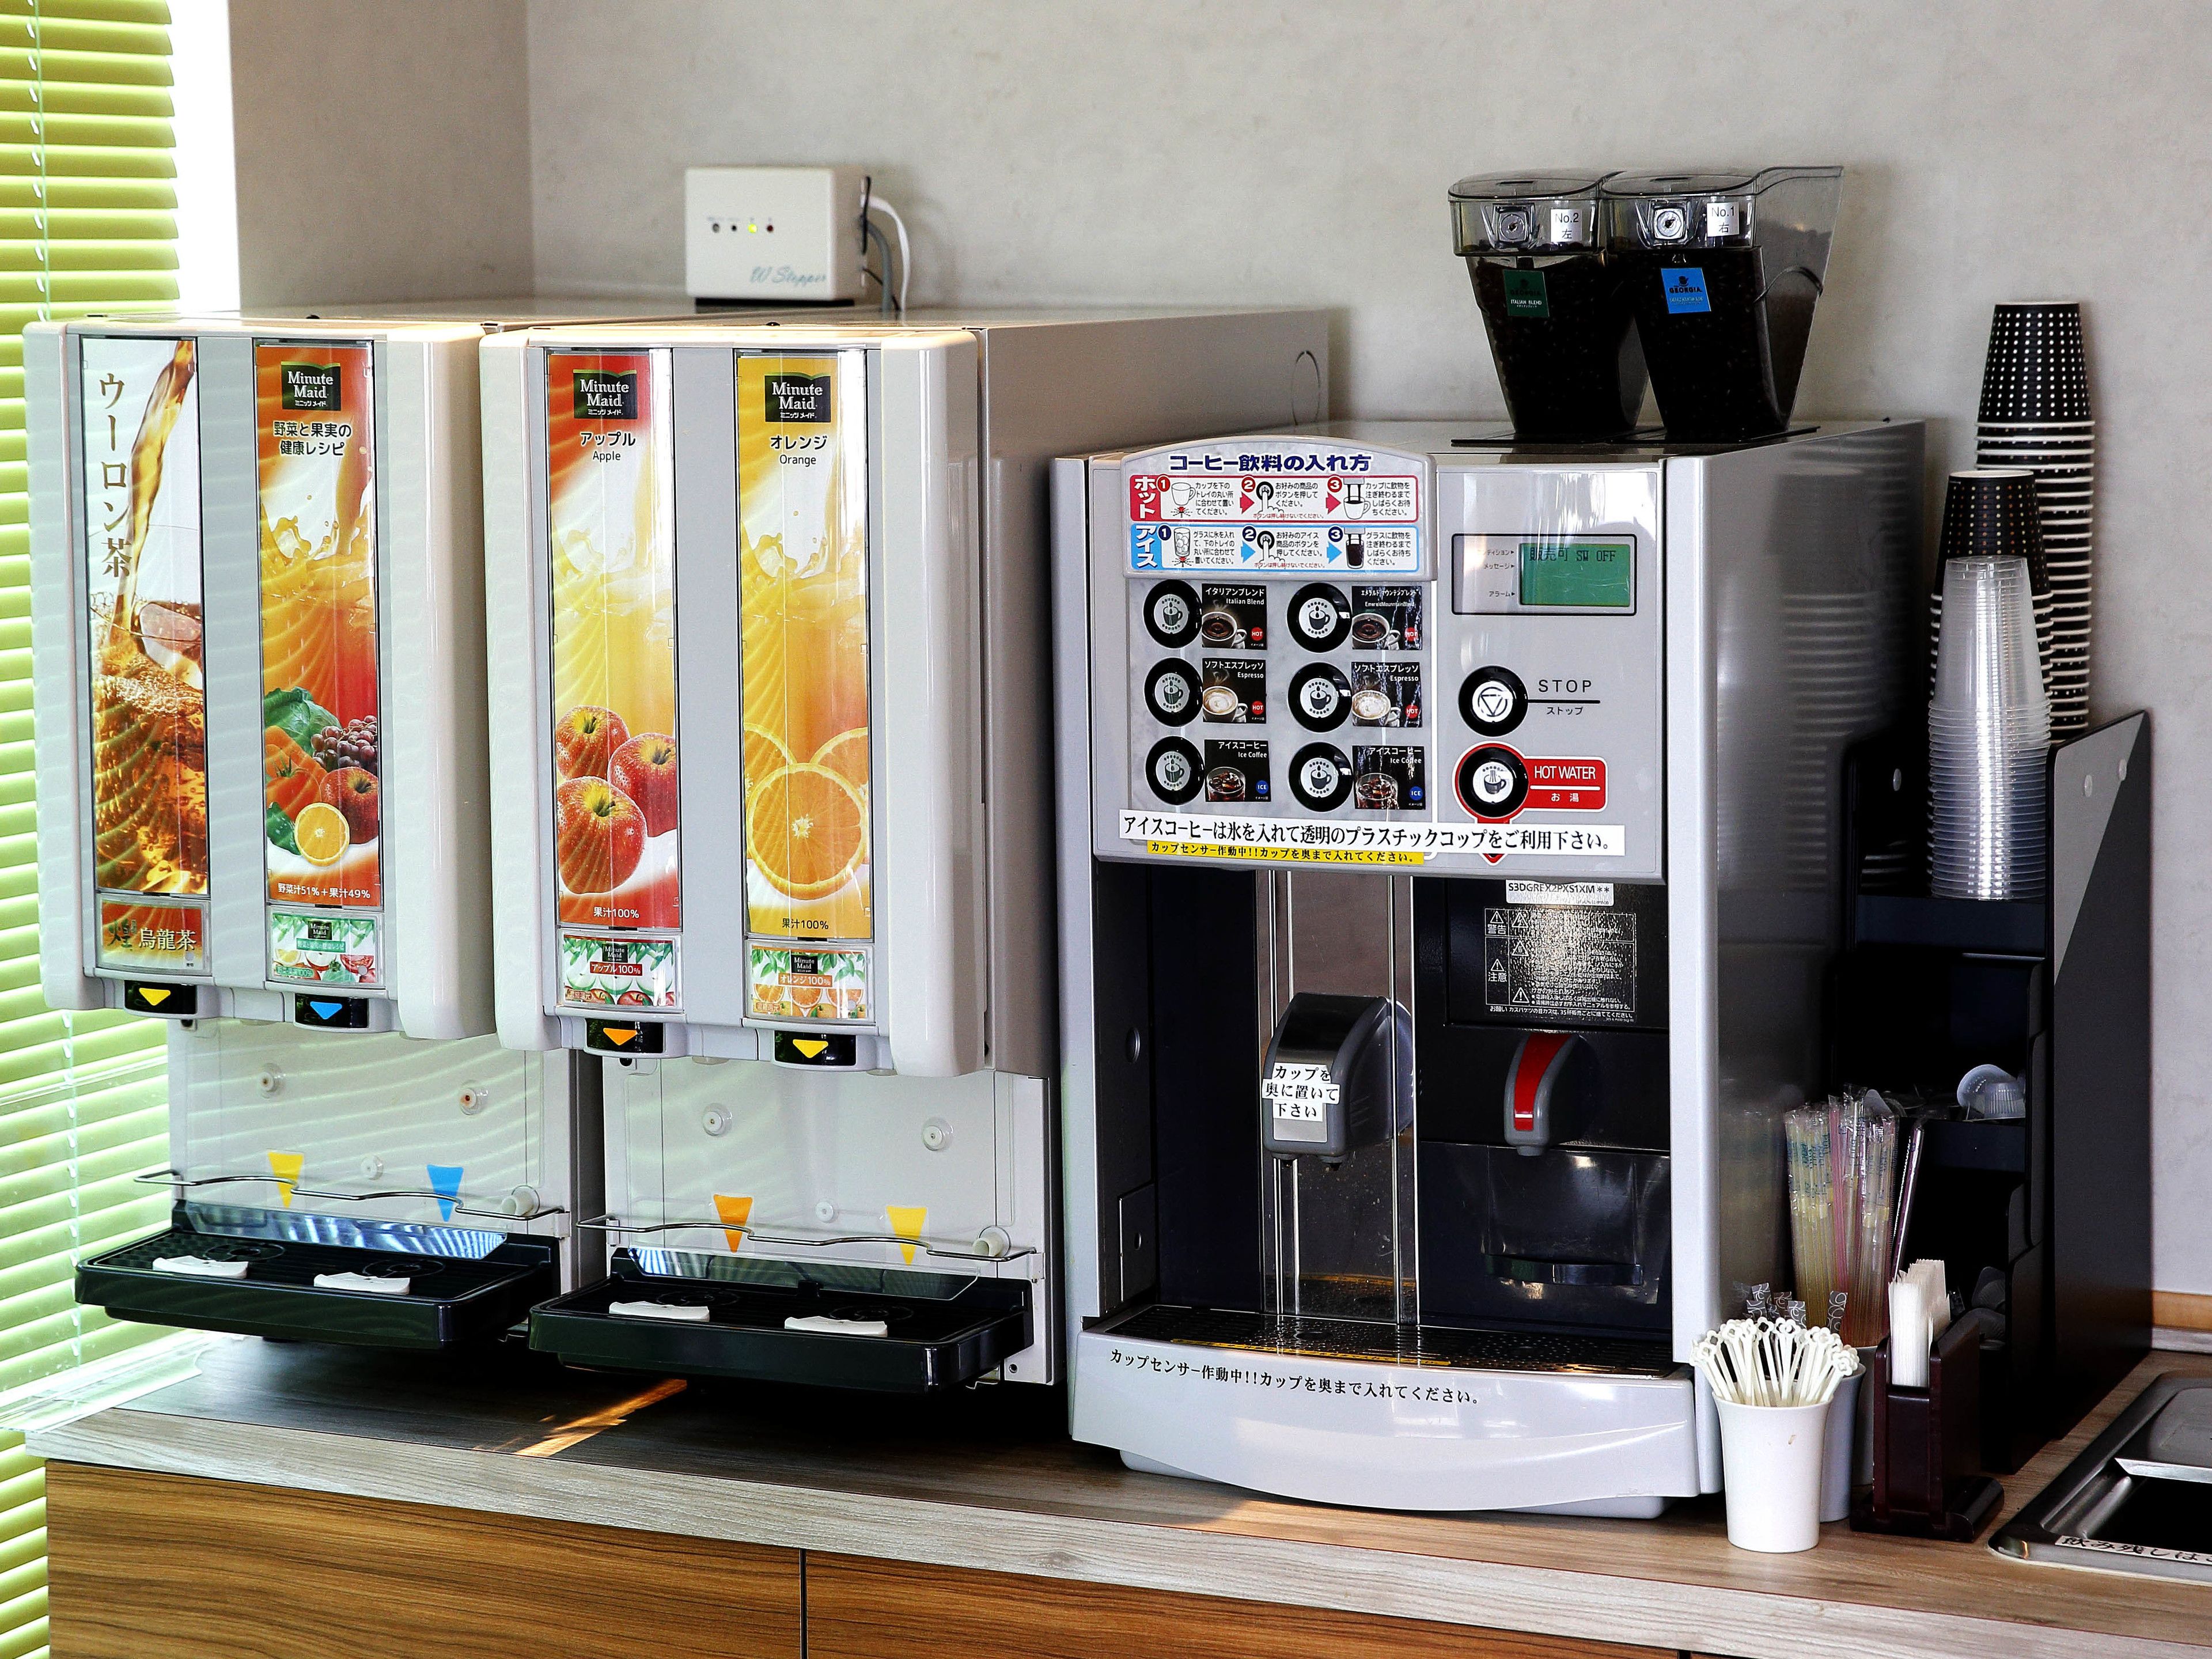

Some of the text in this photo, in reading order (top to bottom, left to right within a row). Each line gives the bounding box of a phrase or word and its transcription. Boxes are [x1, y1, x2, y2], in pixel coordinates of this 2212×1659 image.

[1555, 213, 1579, 223] No.2
[1711, 207, 1735, 217] No.1
[1562, 229, 1572, 239] 左
[1718, 223, 1729, 233] 右
[288, 371, 334, 385] Minute
[294, 385, 327, 399] Maid
[579, 379, 630, 393] Minute
[772, 382, 823, 396] Minute
[586, 394, 623, 407] Maid
[779, 397, 816, 410] Maid
[274, 422, 352, 438] 野菜と果実の
[579, 431, 637, 447] アップル
[770, 435, 828, 450] オレンジ
[280, 441, 345, 456] 健康レシピ
[593, 450, 621, 463] Apple
[779, 454, 816, 467] Orange
[1169, 454, 1372, 472] コーヒー飲料の入れ方
[99, 372, 132, 578] ウーロン茶
[1134, 476, 1156, 519] ホット
[1136, 525, 1158, 569] アイス
[1596, 550, 1616, 562] OFF
[1205, 587, 1265, 597] イタリアンブレンド
[1205, 661, 1264, 670] ソフトエスプレッソ
[1354, 664, 1419, 673] ソフトエスプレッソ
[1538, 679, 1592, 693] STOP
[1547, 706, 1584, 715] ストップ
[1218, 741, 1267, 749] アイスコーヒー
[1368, 747, 1422, 755] アイスコーヒー
[1534, 766, 1596, 780] HOT WATER
[1124, 816, 1609, 850] アイスコーヒーは氷を入れて透明のプラスチックコップをご利用下さい。
[593, 906, 639, 919] 果汁100%
[782, 918, 829, 930] 果汁100%
[1487, 924, 1507, 935] 警告
[138, 927, 197, 951] 烏龍茶
[591, 964, 641, 975] アップル100%
[1488, 971, 1508, 983] 注意
[1274, 1066, 1331, 1081] カップを
[1265, 1082, 1338, 1101] 奥に置いて
[1274, 1103, 1317, 1118] 下さい
